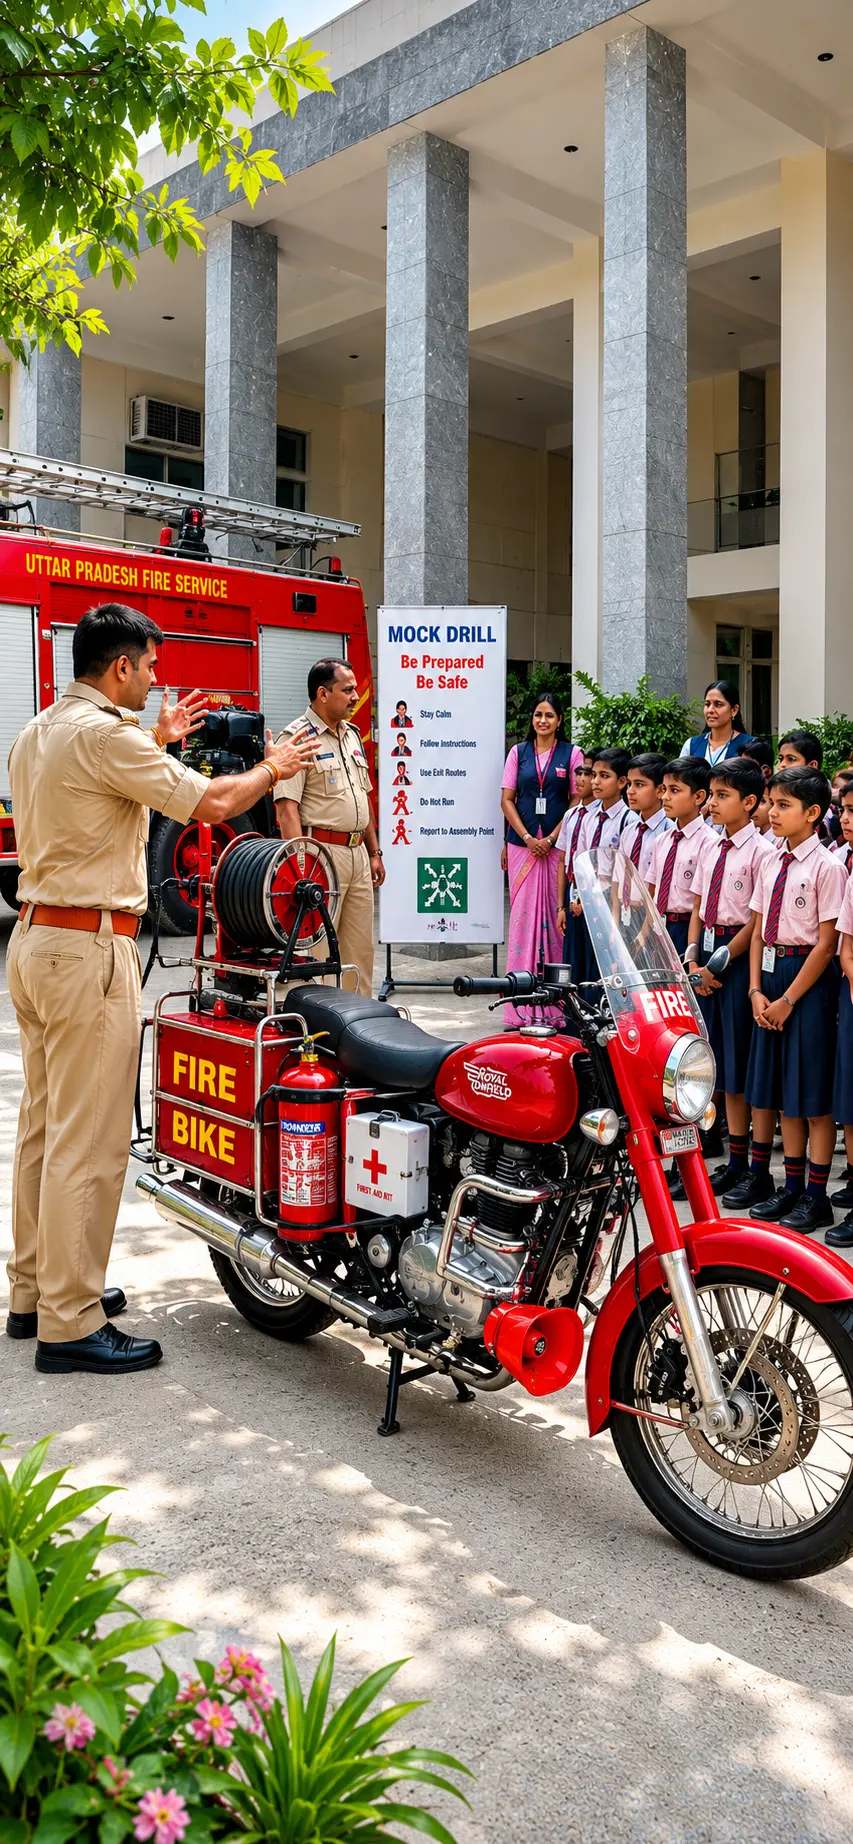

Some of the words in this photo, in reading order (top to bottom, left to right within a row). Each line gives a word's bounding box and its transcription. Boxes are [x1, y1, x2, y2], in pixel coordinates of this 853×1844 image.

[25, 552, 71, 578] UTTAR
[75, 560, 138, 587] PRADESH
[142, 569, 171, 591] FIRE
[175, 573, 228, 598] SERVICE
[388, 626, 441, 643] MOCK
[446, 626, 497, 643] DRILL
[401, 654, 418, 669] Be
[422, 654, 484, 672] Prepared
[416, 675, 434, 689] Be
[438, 675, 468, 689] Safe
[420, 709, 434, 720] Stay
[435, 709, 452, 718] Calm
[420, 739, 440, 748] Follow
[440, 739, 477, 748] Instructions
[419, 768, 432, 777] Use
[433, 768, 444, 777] Exit
[445, 768, 467, 777] Routes
[420, 797, 429, 806] Do
[430, 797, 441, 806] Not
[442, 797, 455, 806] Run
[420, 826, 440, 837] Report
[441, 827, 448, 836] to
[449, 826, 478, 838] Assembly
[478, 826, 495, 836] Point
[640, 990, 693, 1022] FIRE
[173, 1050, 237, 1104] FIRE
[477, 1066, 508, 1087] ROYAL
[172, 1109, 236, 1166] BIKE
